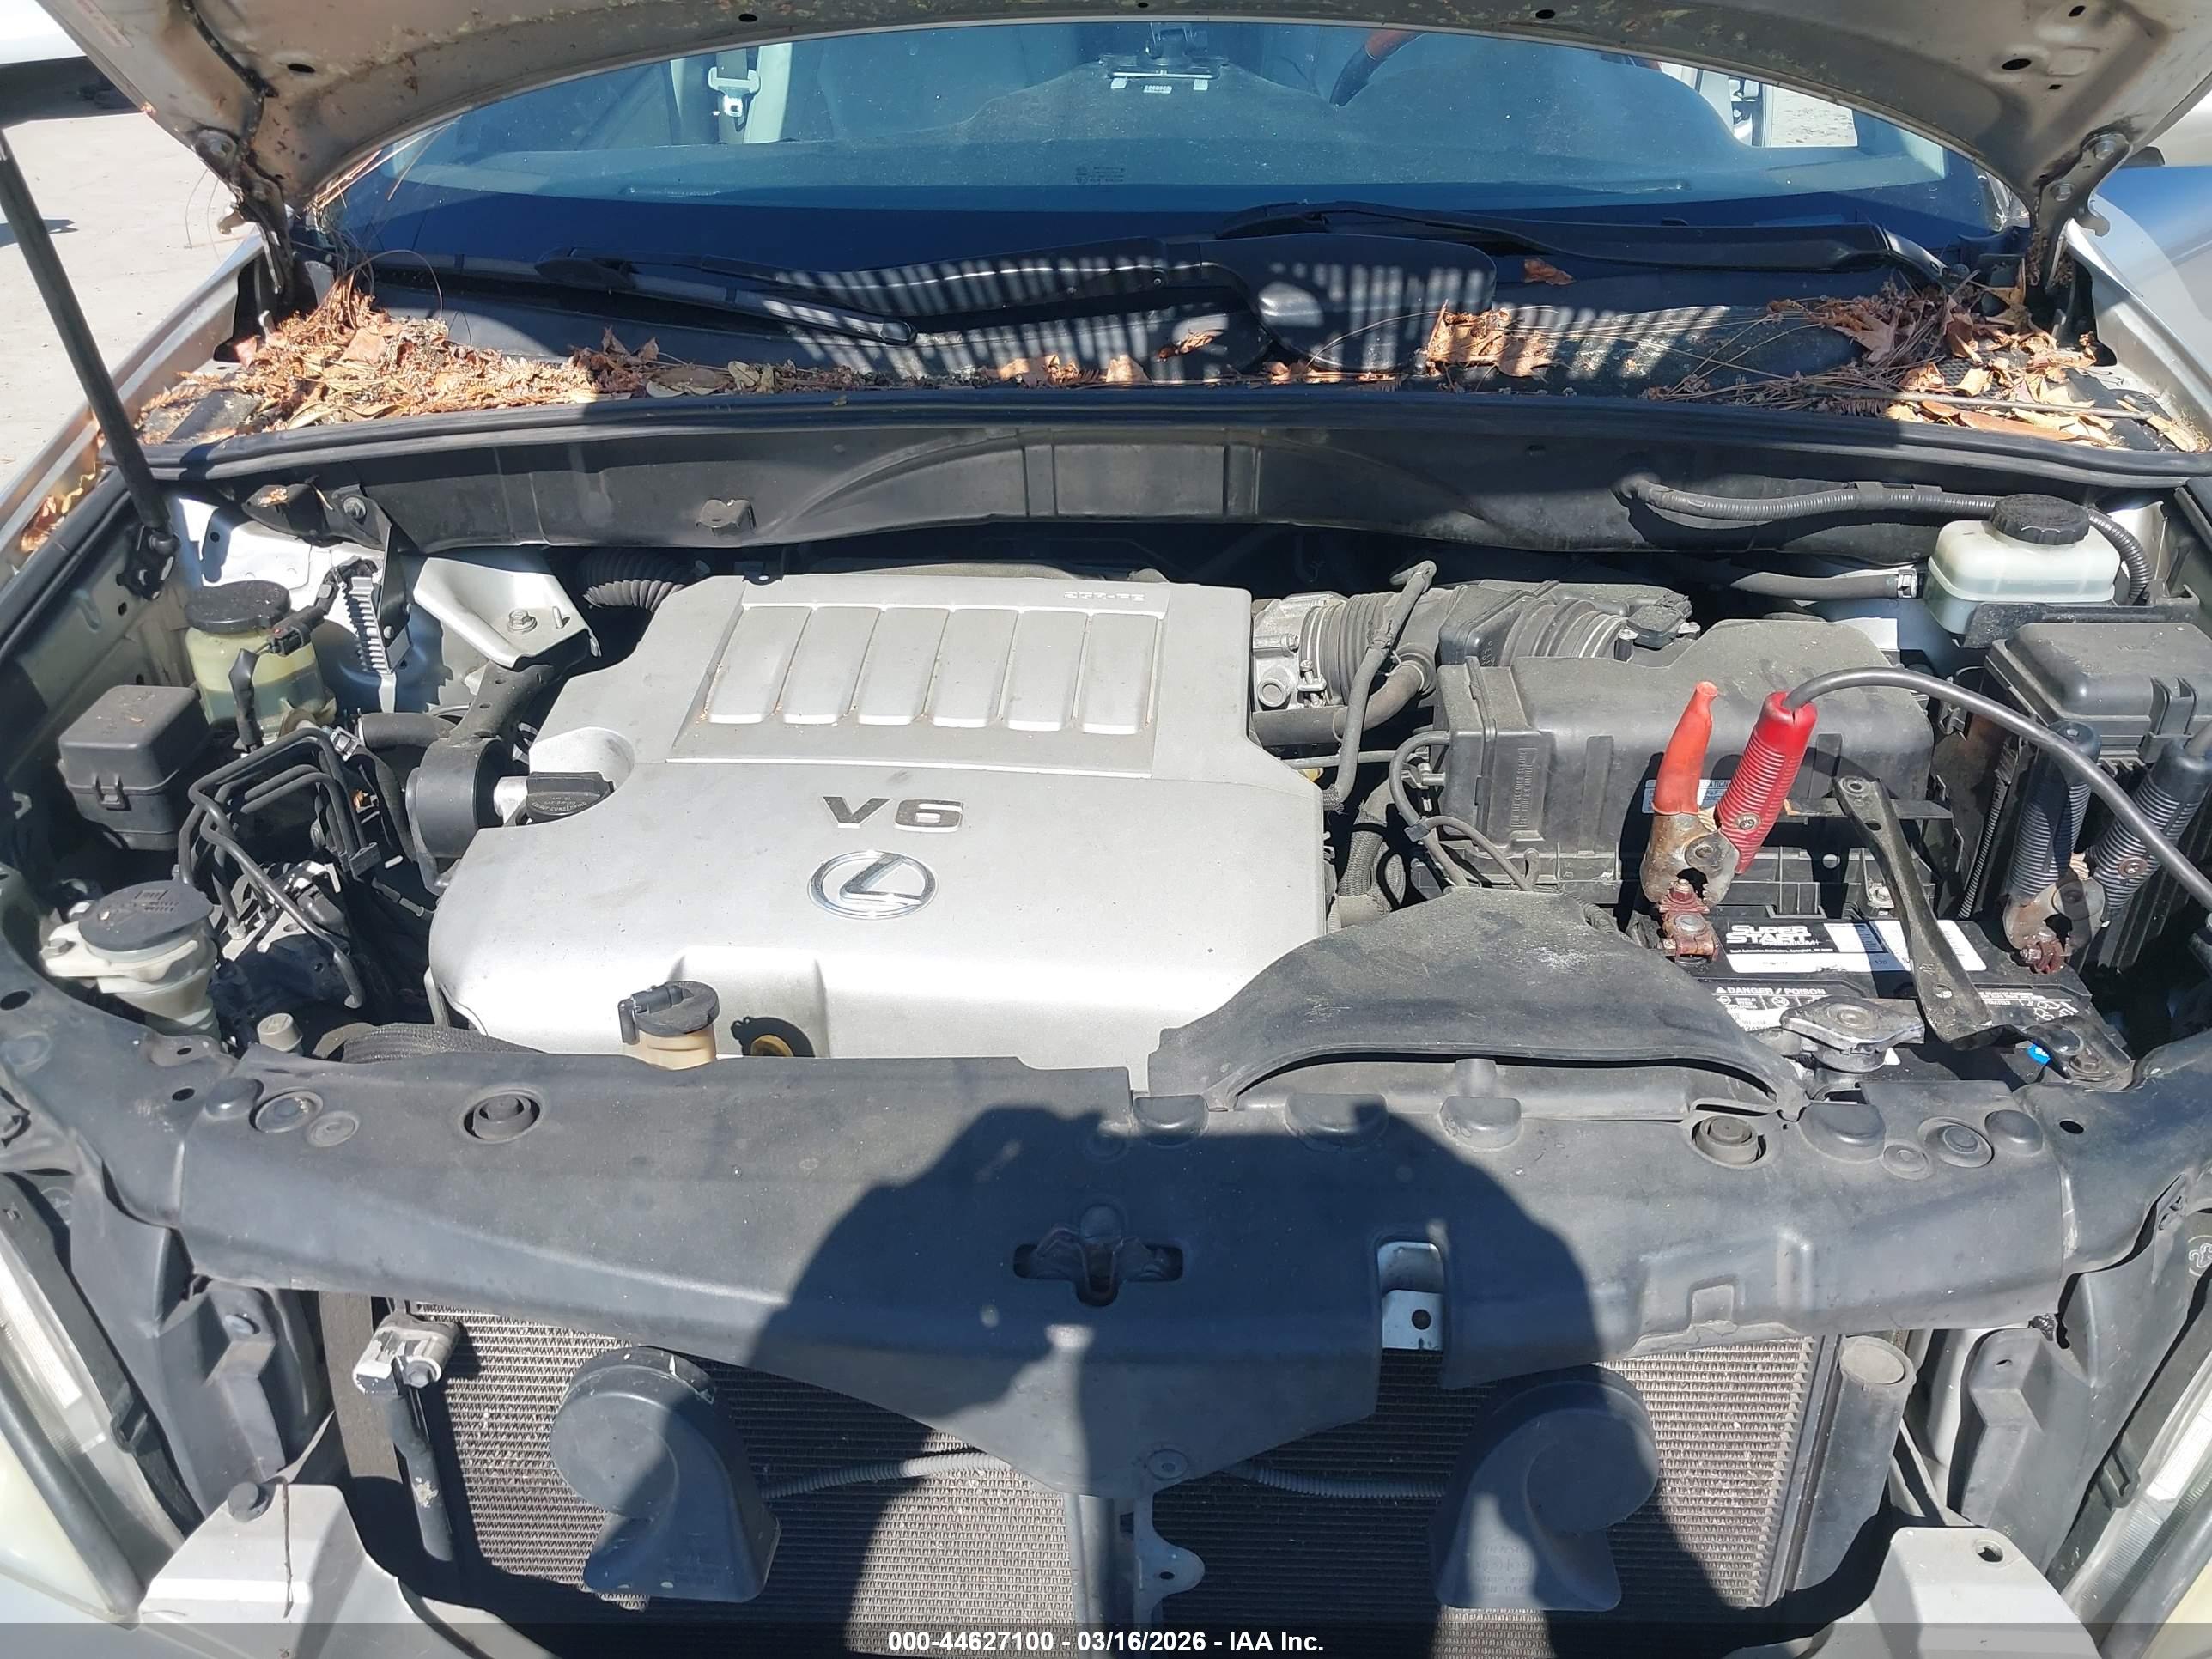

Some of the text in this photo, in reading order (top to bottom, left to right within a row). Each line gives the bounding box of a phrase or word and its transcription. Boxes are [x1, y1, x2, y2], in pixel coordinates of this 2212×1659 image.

[822, 796, 964, 833] V6
[1731, 925, 1808, 934] SUPER
[1726, 933, 1812, 944] START
